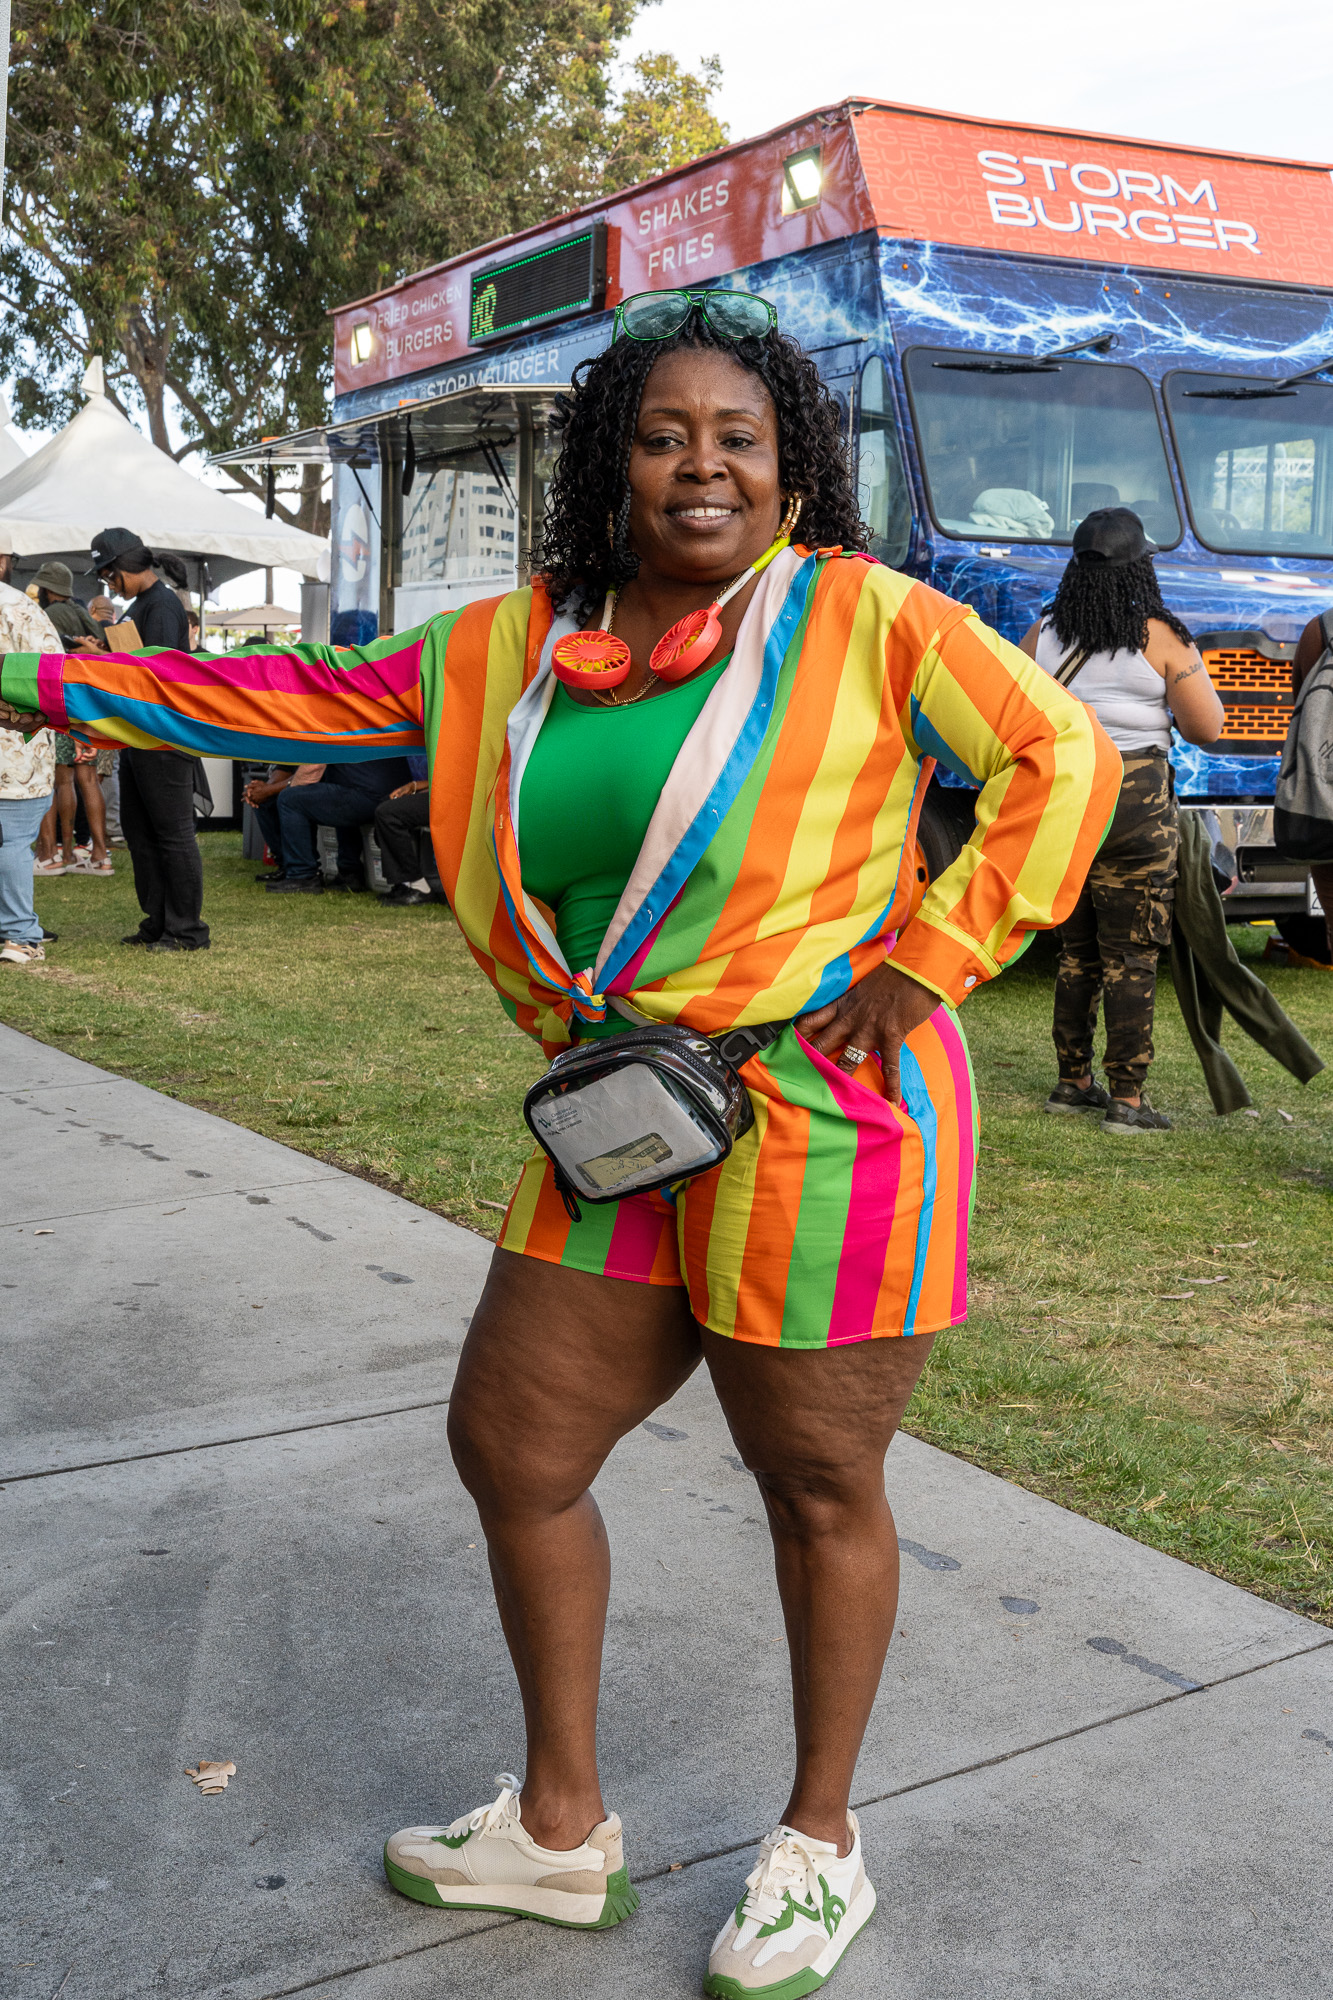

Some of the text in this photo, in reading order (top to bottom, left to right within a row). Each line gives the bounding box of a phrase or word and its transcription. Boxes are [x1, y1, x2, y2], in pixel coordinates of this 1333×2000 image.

[977, 149, 1219, 212] STORM
[638, 179, 729, 235] SHAKES
[986, 190, 1262, 254] BURGER
[648, 232, 714, 278] FRIES
[378, 304, 408, 329] FRIED
[411, 284, 463, 317] CHICKEN
[386, 320, 453, 359] BURGERS
